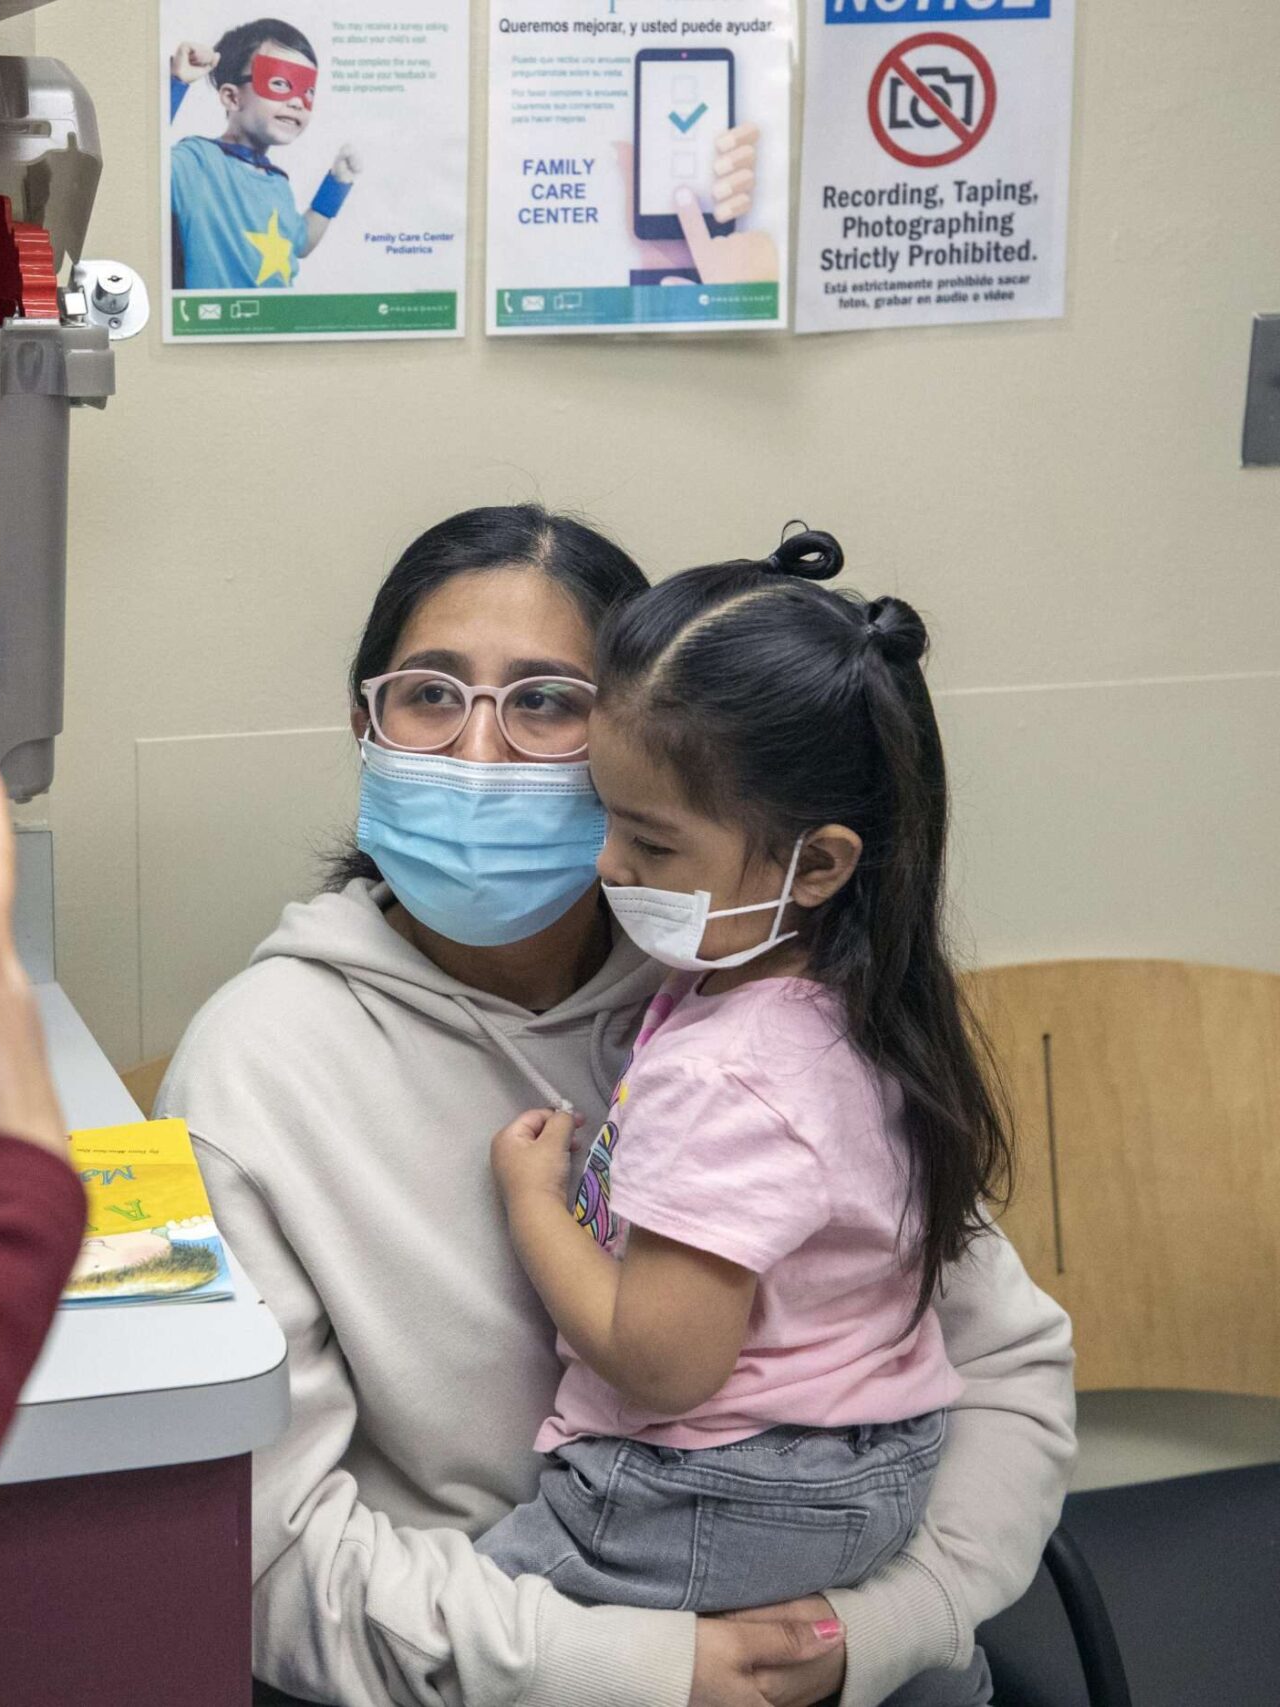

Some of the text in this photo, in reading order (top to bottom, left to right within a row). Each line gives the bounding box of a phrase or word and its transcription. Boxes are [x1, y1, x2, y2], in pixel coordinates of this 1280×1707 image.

[499, 18, 569, 33] Queremos
[573, 18, 626, 36] mejorar,
[630, 22, 637, 36] y
[642, 18, 677, 33] usted
[681, 18, 722, 36] puede
[523, 159, 595, 175] FAMILY
[531, 183, 586, 200] CARE
[822, 179, 1038, 209] Recording, Taping,
[518, 207, 599, 224] CENTER
[842, 210, 1015, 241] Photographing
[364, 232, 455, 243] Family Care Center
[386, 245, 433, 254] Pediatrics
[820, 239, 1038, 272] Strictly Prohibited.
[824, 275, 1030, 294] Está estrictamente prohibido sacar
[838, 297, 869, 310] fotos,
[873, 294, 913, 309] grabar
[917, 295, 931, 304] en
[936, 291, 968, 303] audio
